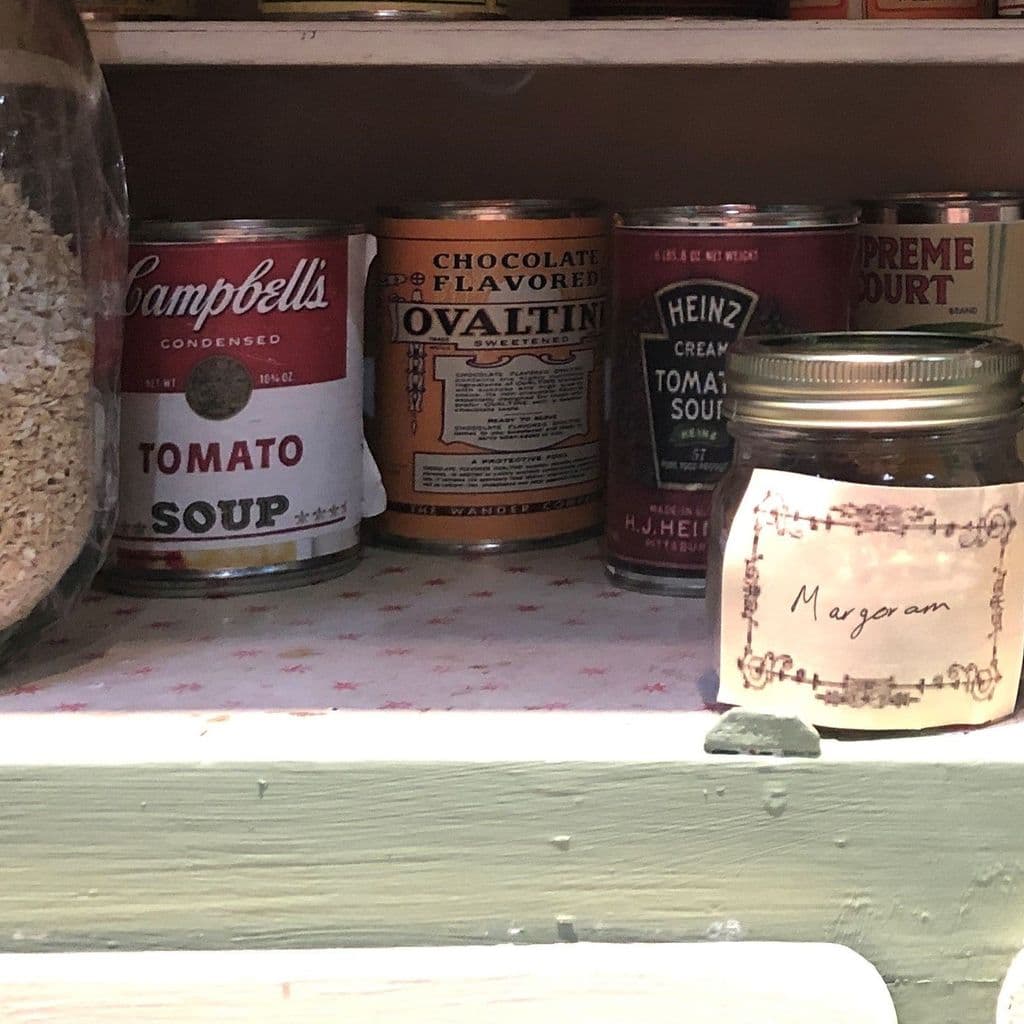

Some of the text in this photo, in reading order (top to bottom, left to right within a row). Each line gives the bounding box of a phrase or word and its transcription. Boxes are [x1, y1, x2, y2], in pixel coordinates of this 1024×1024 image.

[433, 250, 600, 269] CHOCOLATE
[124, 255, 329, 332] Campbell's
[434, 272, 598, 292] FLAVORED
[668, 296, 742, 328] HEINZ
[160, 334, 280, 350] CONDENSED
[474, 336, 569, 346] SWEETENED
[139, 434, 304, 474] TOMATO
[152, 494, 290, 534] SOUP
[452, 504, 530, 515] WANDER
[790, 584, 950, 639] Margoram
